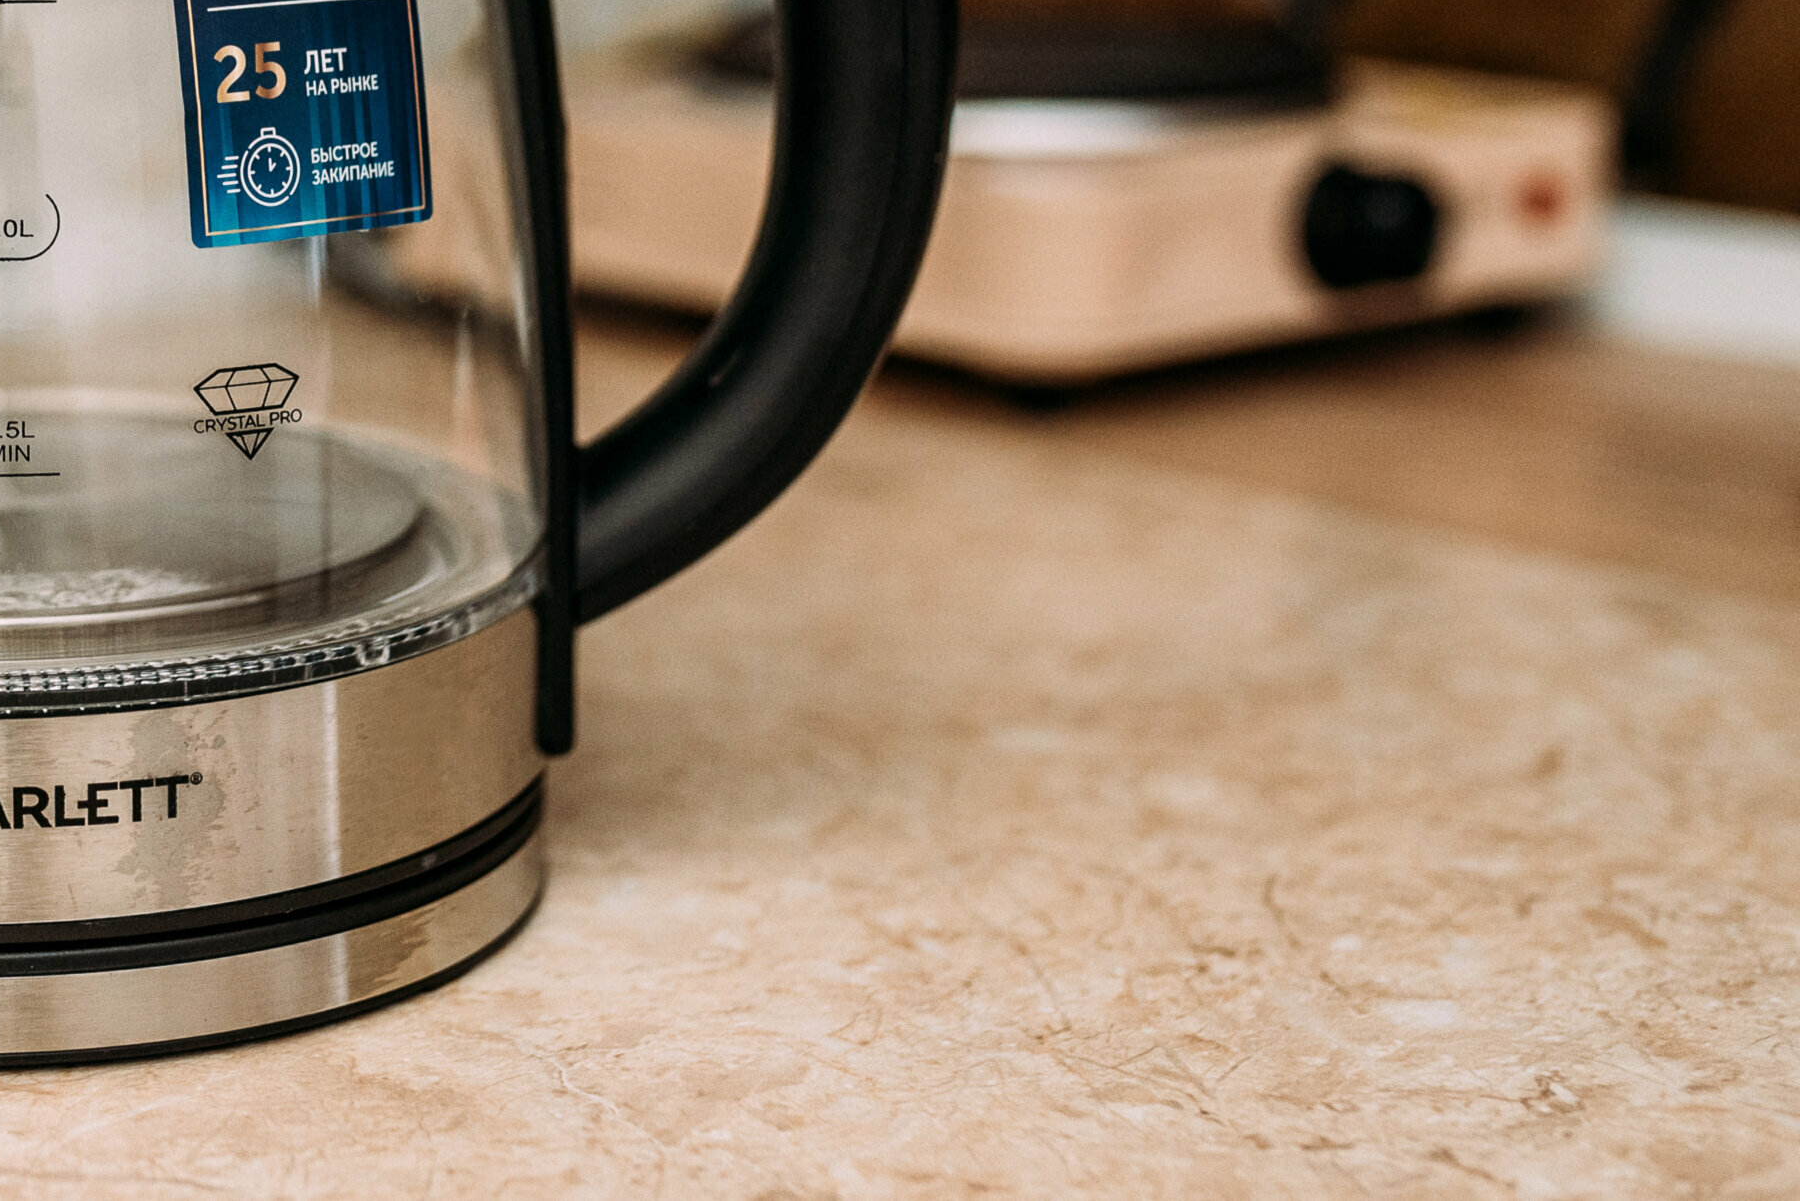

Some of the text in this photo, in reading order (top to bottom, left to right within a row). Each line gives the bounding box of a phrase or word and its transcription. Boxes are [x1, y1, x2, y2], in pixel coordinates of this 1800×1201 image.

[213, 41, 287, 104] 25
[303, 47, 347, 75] ЛЕТ
[305, 74, 379, 97] НА РЫНКЕ
[310, 141, 379, 164] БЫСТРОЕ
[311, 160, 395, 186] ЗАКИПАНИЕ
[193, 408, 303, 434] CRYSTAL PRO
